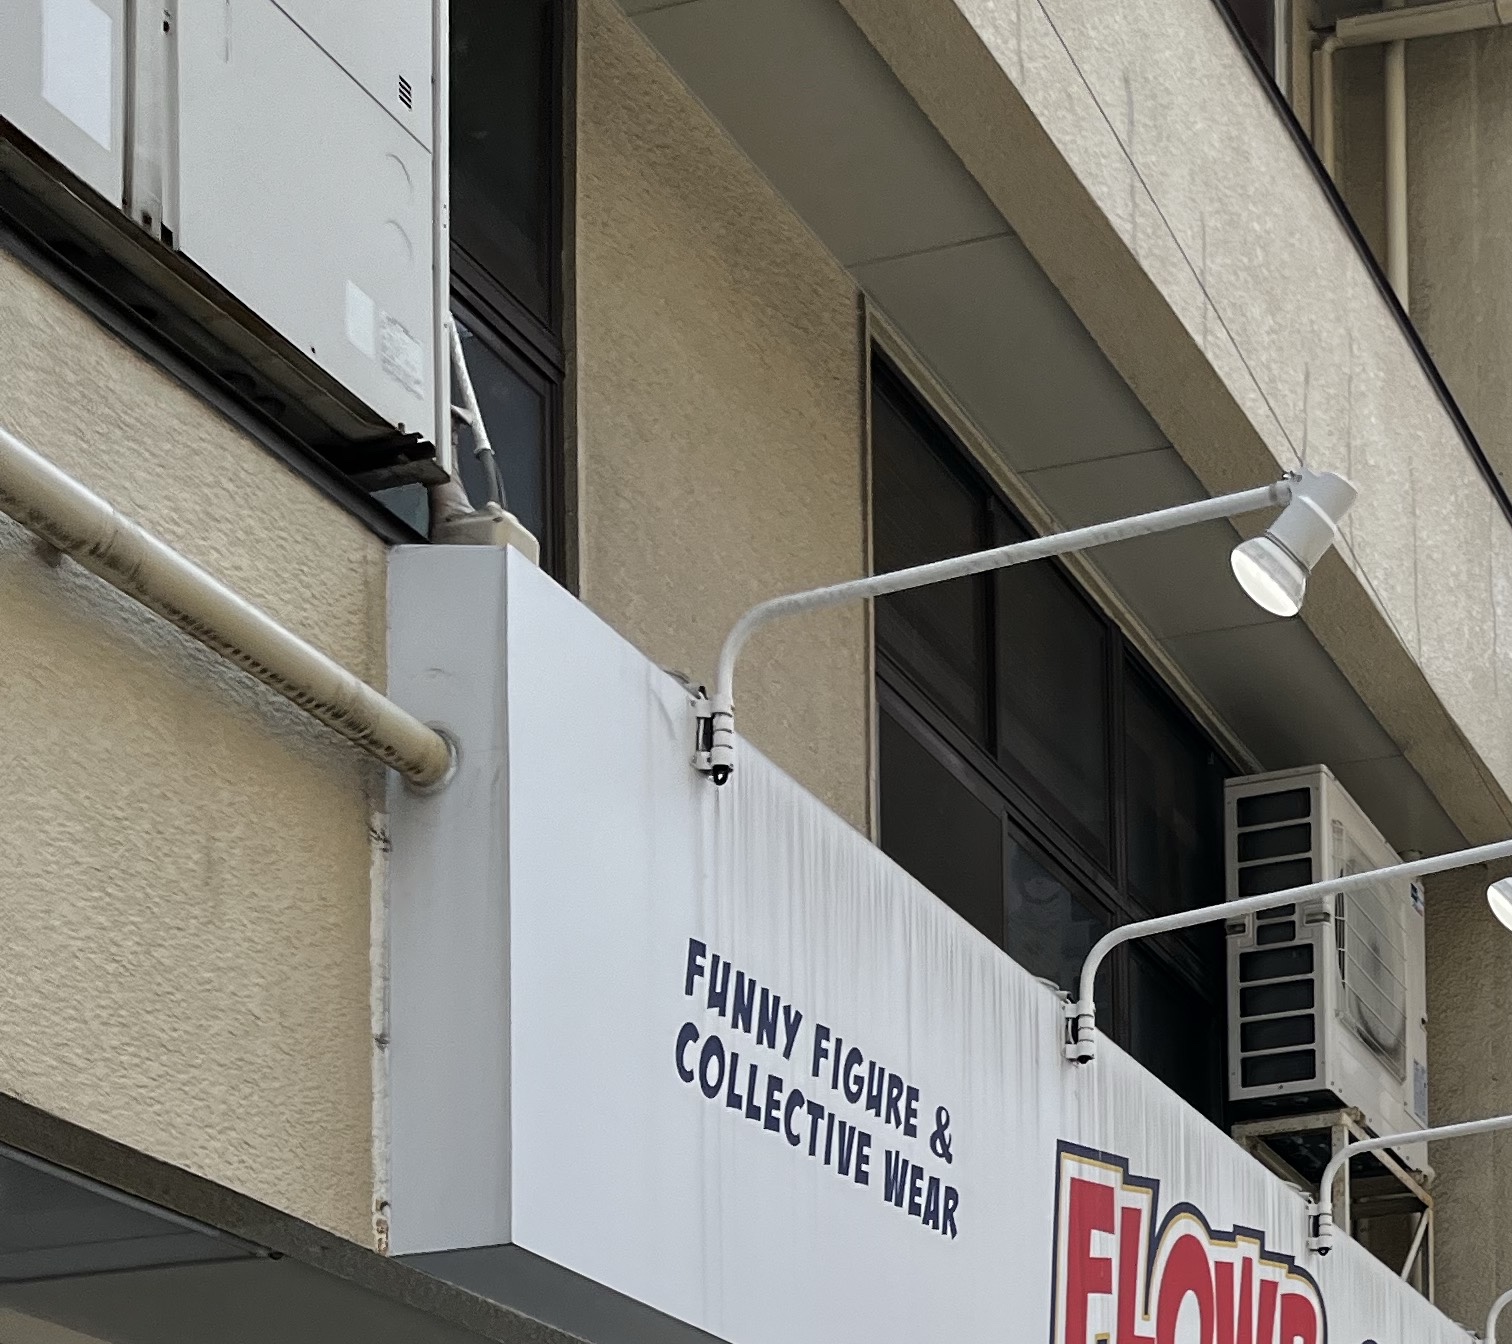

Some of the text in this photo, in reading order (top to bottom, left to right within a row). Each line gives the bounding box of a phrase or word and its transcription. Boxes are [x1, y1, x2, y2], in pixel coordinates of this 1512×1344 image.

[675, 1021, 959, 1240] COLLECTIVE WEAR
[685, 937, 953, 1165] FUNNY FIGURE &
